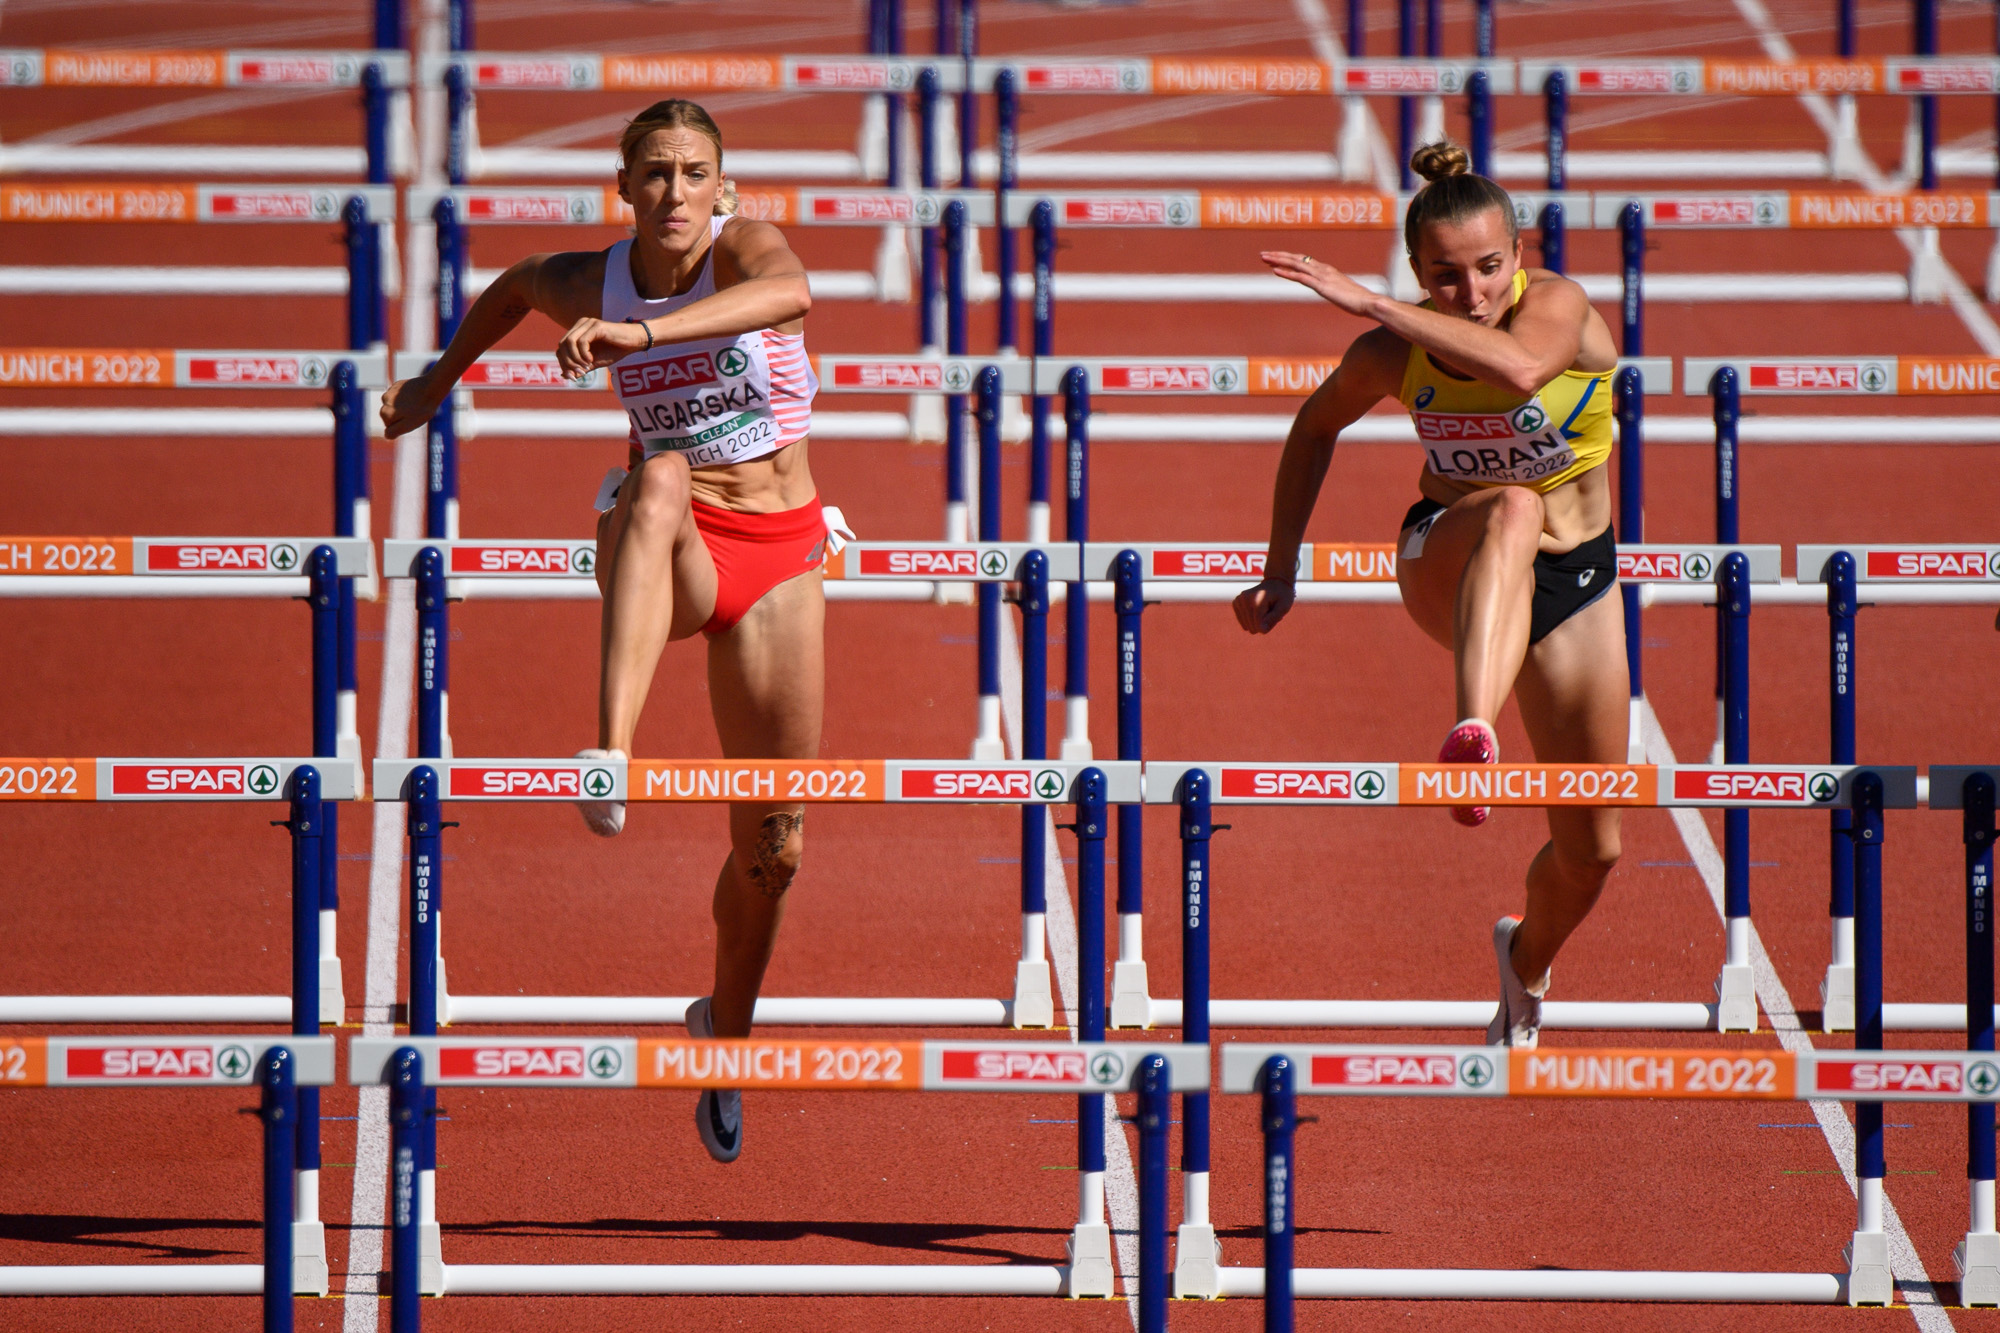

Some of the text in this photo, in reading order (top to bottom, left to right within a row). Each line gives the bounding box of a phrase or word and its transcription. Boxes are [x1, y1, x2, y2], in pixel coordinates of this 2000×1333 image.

[615, 61, 706, 86] MUNICH
[1165, 66, 1257, 91] MUNICH
[12, 192, 184, 218] MUNICH 2022
[234, 197, 311, 216] SPAR
[493, 199, 567, 219] SPAR
[737, 194, 786, 220] 022
[838, 198, 913, 219] SPAR
[1088, 200, 1164, 222] SPAR
[1213, 200, 1383, 224] MUNICH 2022
[1677, 200, 1752, 222] SPAR
[1802, 198, 1976, 223] MUNICH 2022
[93, 355, 161, 384] 2022
[215, 361, 298, 382] SPAR
[486, 362, 566, 382] SPAR
[620, 357, 713, 392] SPAR
[860, 365, 942, 386] SPAR
[1129, 367, 1208, 388] SPAR
[1263, 364, 1339, 390] MUN
[1776, 366, 1857, 388] SPAR
[1912, 364, 2000, 391] MUNIC
[630, 382, 763, 433] LIGARSKA
[728, 421, 772, 454] 2022
[1420, 417, 1511, 438] SPAR
[675, 437, 698, 448] RUN
[1430, 432, 1560, 474] LOBAN
[1523, 453, 1568, 480] 2022
[43, 545, 116, 570] 2022
[178, 547, 266, 568] SPAR
[480, 549, 568, 571] SPAR
[888, 551, 976, 572] SPAR
[1182, 552, 1265, 574] SPAR
[1330, 551, 1397, 577] MUN
[1617, 554, 1679, 577] PAR
[1897, 553, 1984, 576] SPAR
[424, 638, 435, 690] MONDO
[1123, 641, 1135, 694] MONDO
[1836, 642, 1848, 694] MONDO
[0, 766, 78, 795] 2022
[146, 768, 243, 792] SPAR
[482, 771, 579, 793] SPAR
[645, 769, 867, 798] MUNICH 2022
[933, 773, 1030, 795] SPAR
[1254, 772, 1350, 795] SPAR
[1416, 770, 1640, 799] MUNICH 2022
[1706, 774, 1803, 797] SPAR
[417, 866, 430, 923] MONDO
[1189, 870, 1202, 928] MONDO
[1973, 875, 1987, 932] MONDO
[102, 1049, 212, 1076] SPAR
[473, 1049, 583, 1075] SPAR
[655, 1047, 904, 1080] MUNICH 2022
[974, 1051, 1085, 1078] SPAR
[1344, 1056, 1455, 1083] SPAR
[1526, 1056, 1777, 1092] MUNICH 2022
[1852, 1063, 1962, 1089] SPAR
